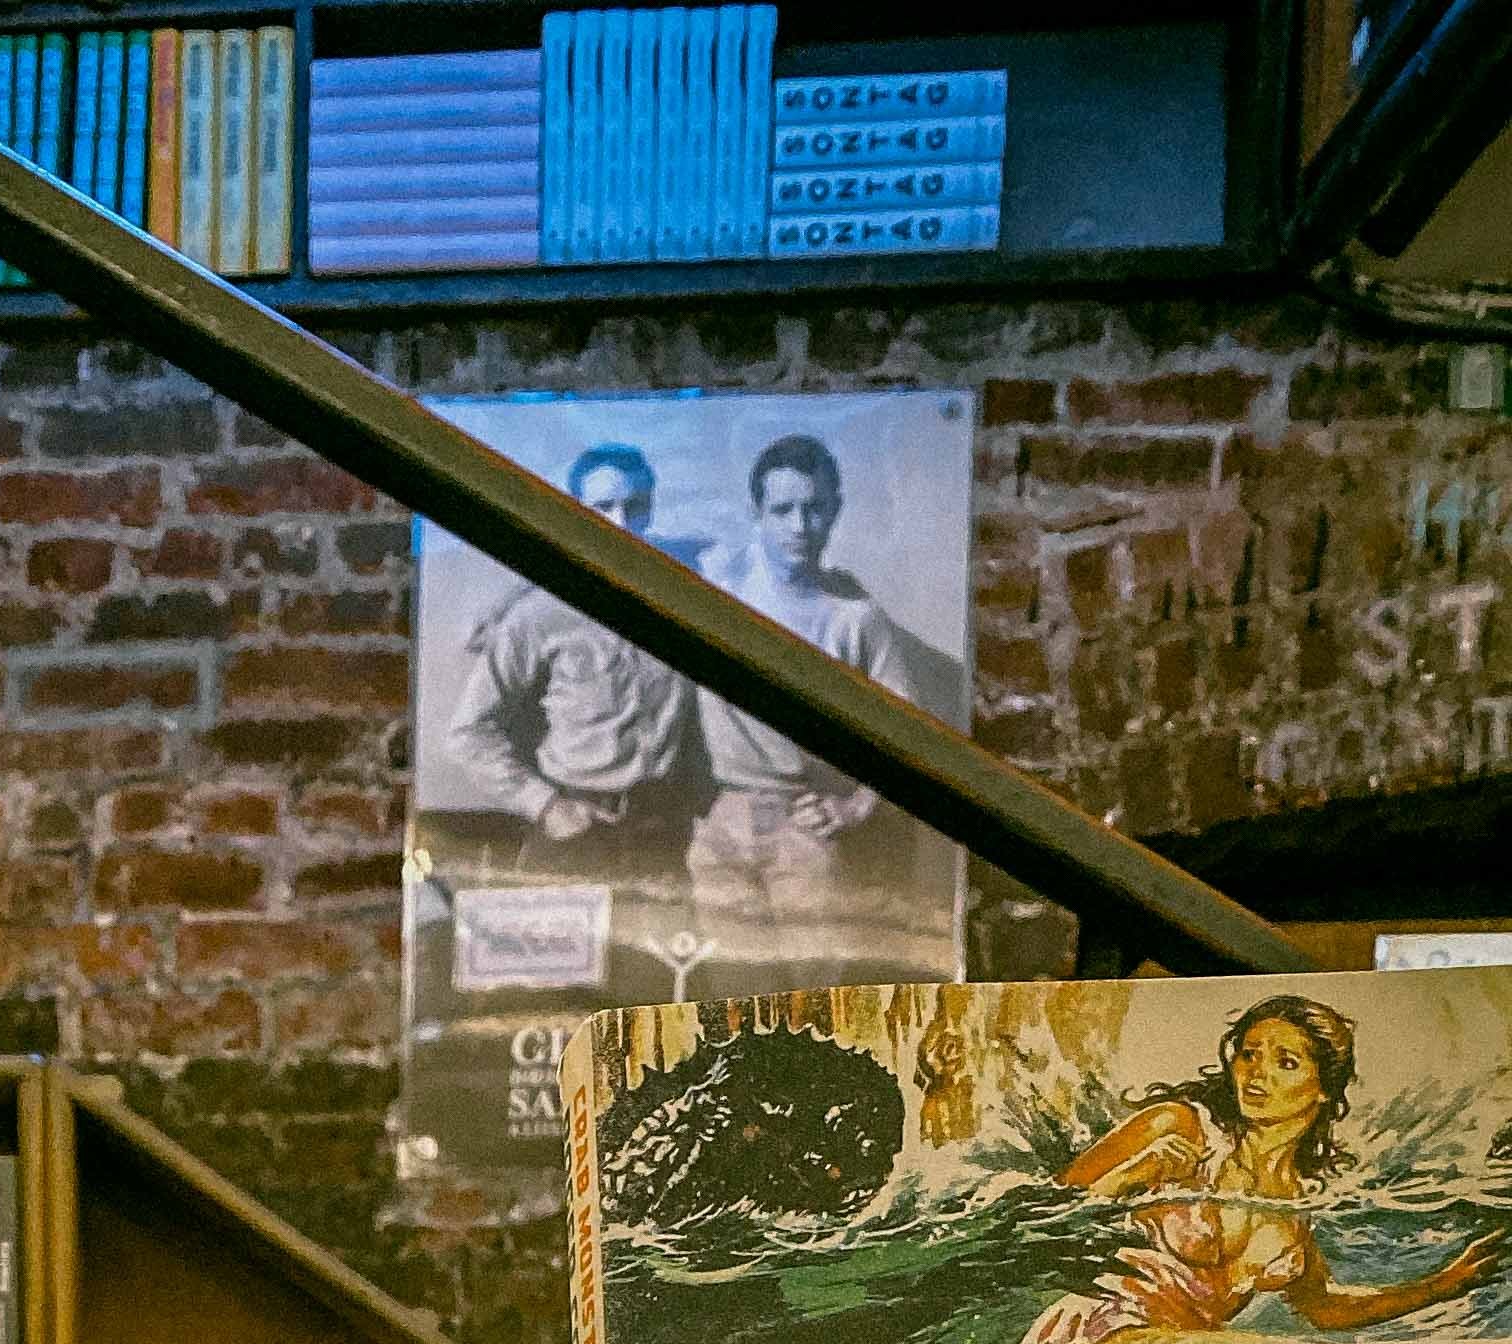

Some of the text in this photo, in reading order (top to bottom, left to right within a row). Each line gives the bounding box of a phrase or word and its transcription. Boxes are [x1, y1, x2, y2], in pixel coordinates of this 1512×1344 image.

[783, 82, 948, 110] SONTAG
[783, 128, 948, 156] SONTAG
[780, 174, 943, 202] SONTAG
[776, 217, 942, 245] SONTAG
